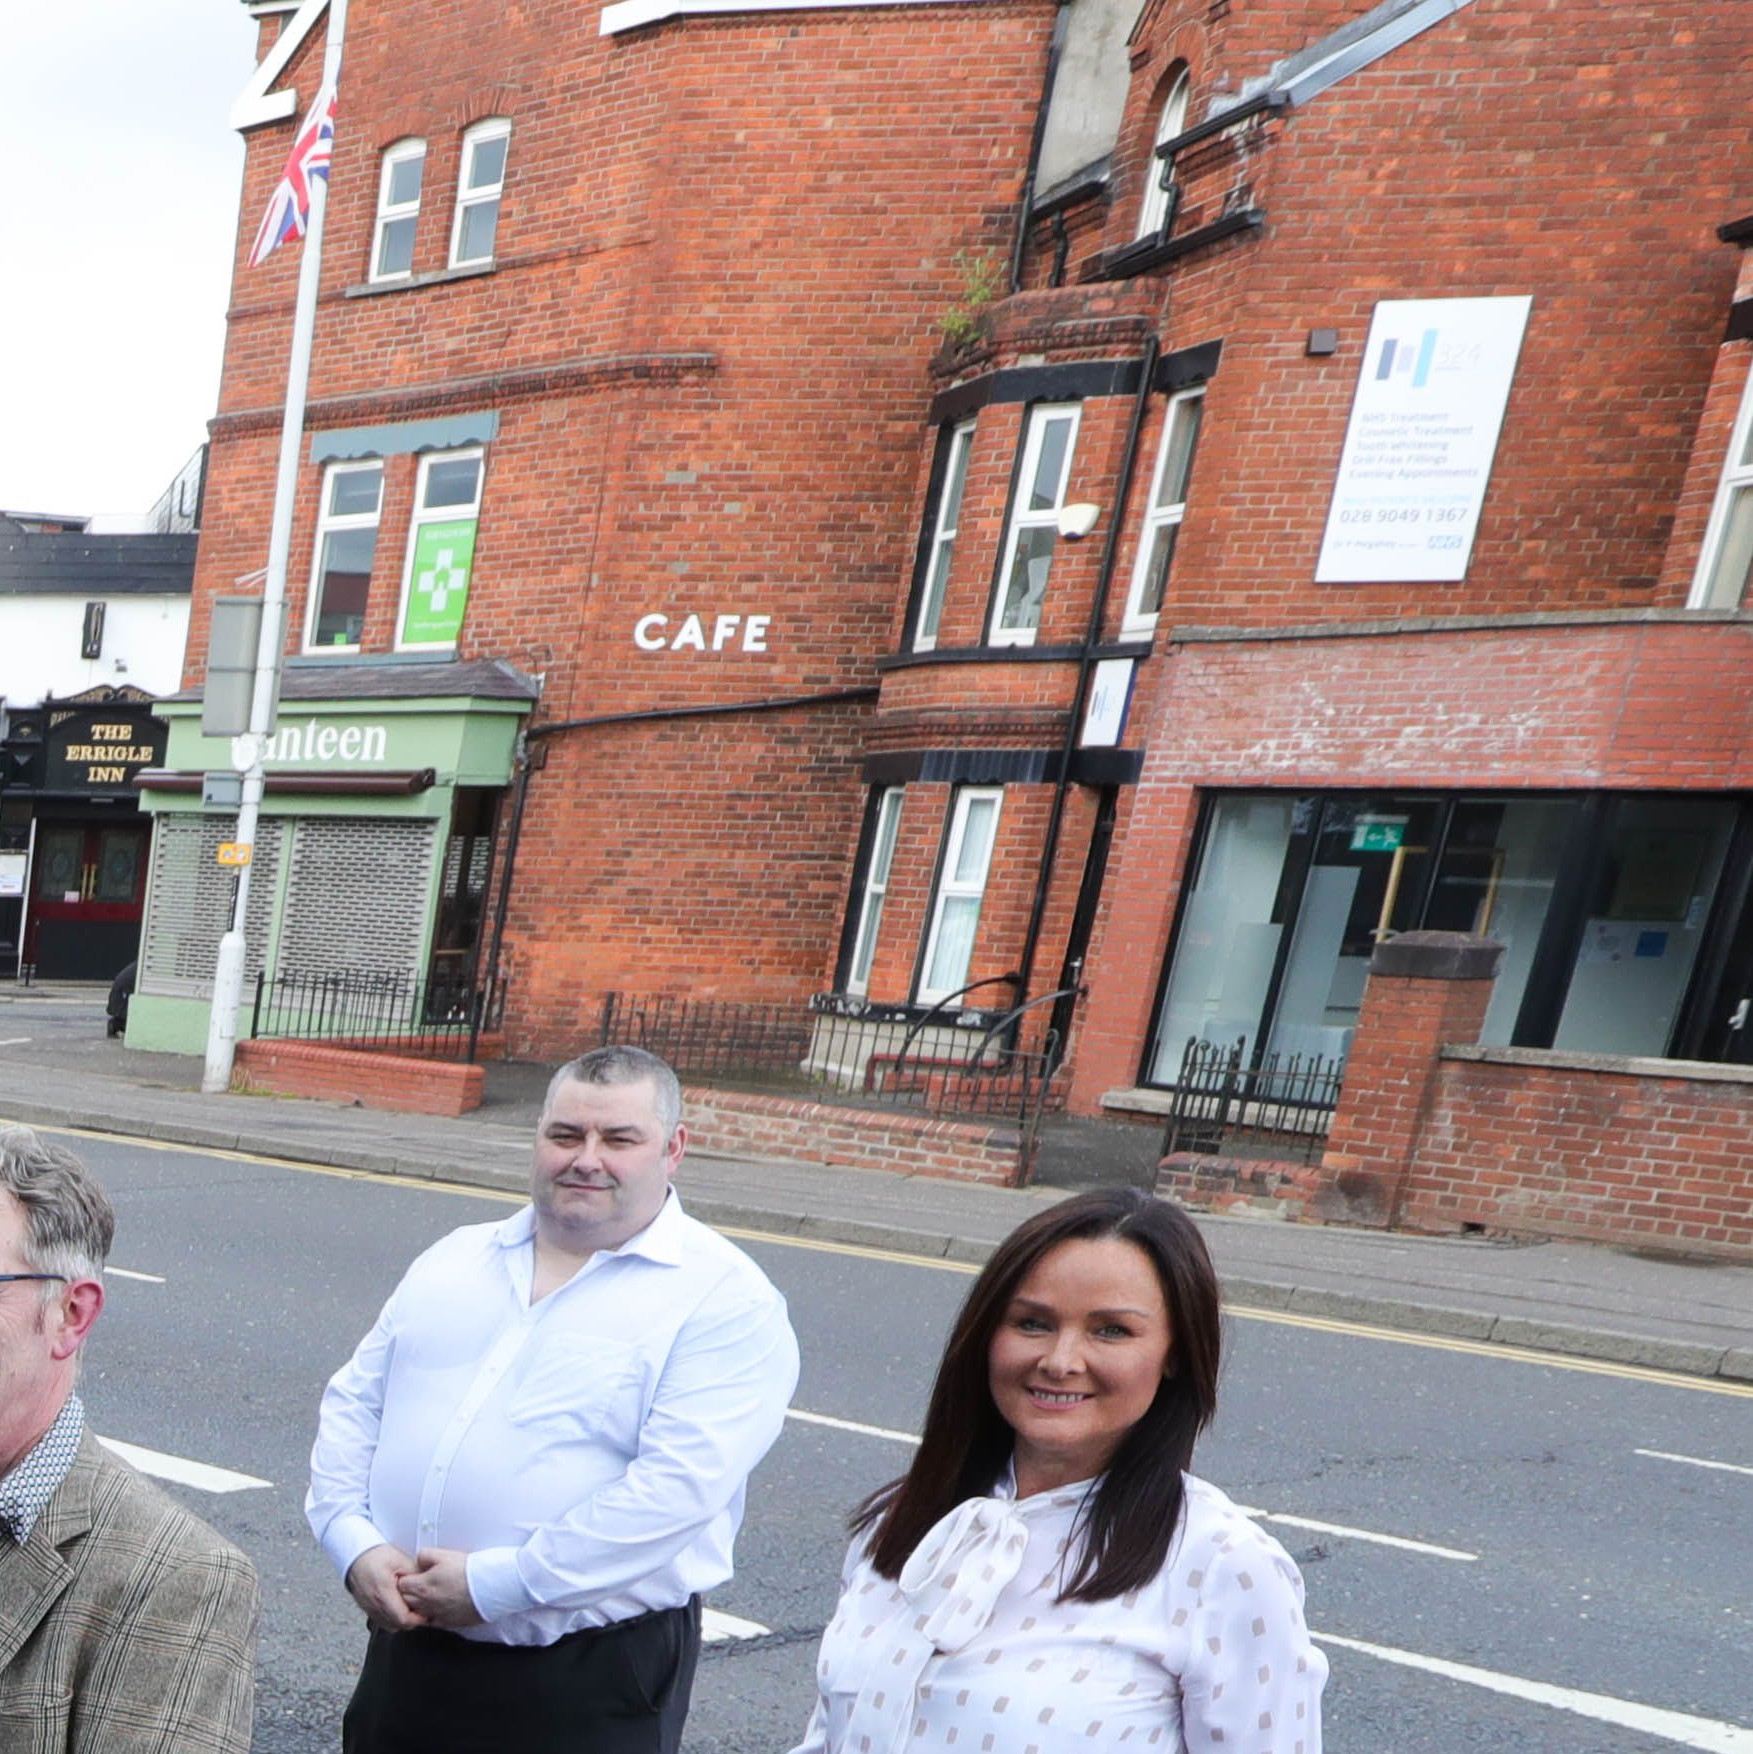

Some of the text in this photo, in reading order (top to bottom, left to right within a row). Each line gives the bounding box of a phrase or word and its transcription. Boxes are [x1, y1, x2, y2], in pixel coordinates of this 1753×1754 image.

[1341, 507, 1468, 523] 028 9049 1367
[634, 613, 772, 652] CAFE
[91, 724, 133, 741] THE
[65, 745, 154, 762] ERRIGLE
[87, 766, 127, 783] INN
